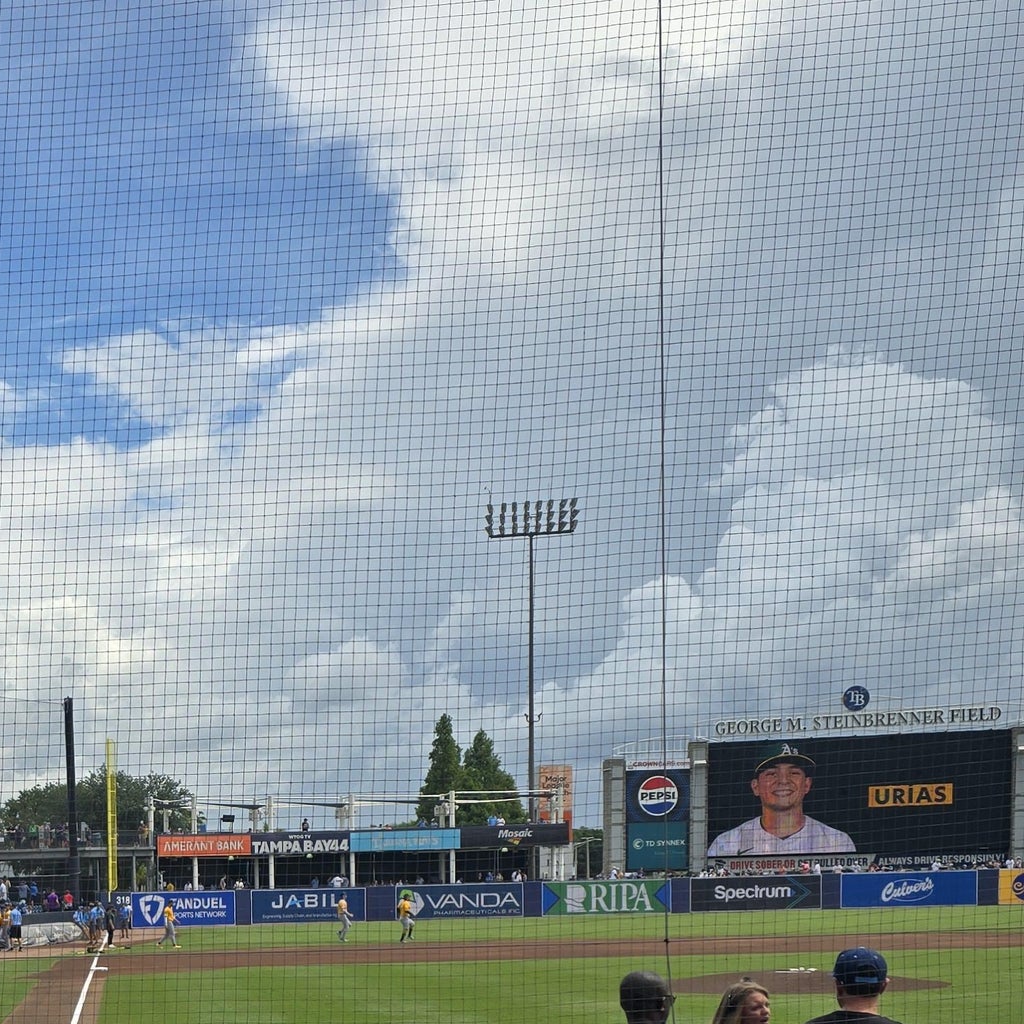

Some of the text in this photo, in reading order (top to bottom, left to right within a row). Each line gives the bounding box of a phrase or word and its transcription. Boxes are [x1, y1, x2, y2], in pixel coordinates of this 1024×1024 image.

[715, 706, 1002, 736] GEORGE M. STEINBRENNER FIELD
[640, 791, 676, 801] PEPSI
[875, 786, 947, 805] URIAS
[498, 827, 533, 839] Mosaic
[163, 840, 244, 852] AMERANT BANK
[252, 840, 303, 854] TAMPA
[656, 839, 686, 847] SYNNEX
[730, 860, 754, 870] DRIVE
[756, 859, 783, 869] SOBER
[784, 859, 796, 868] OR
[878, 856, 913, 866] ALWAYS
[914, 855, 941, 865] DRIVE
[714, 884, 791, 903] Spectrum
[881, 877, 934, 902] Culver's
[116, 896, 130, 905] 318
[271, 893, 338, 909] JABIL
[425, 891, 520, 909] VANDA
[588, 882, 654, 913] RIPA
[174, 910, 227, 919] PORTS NETWORK
[433, 909, 506, 917] PHARMACEUTICALS
